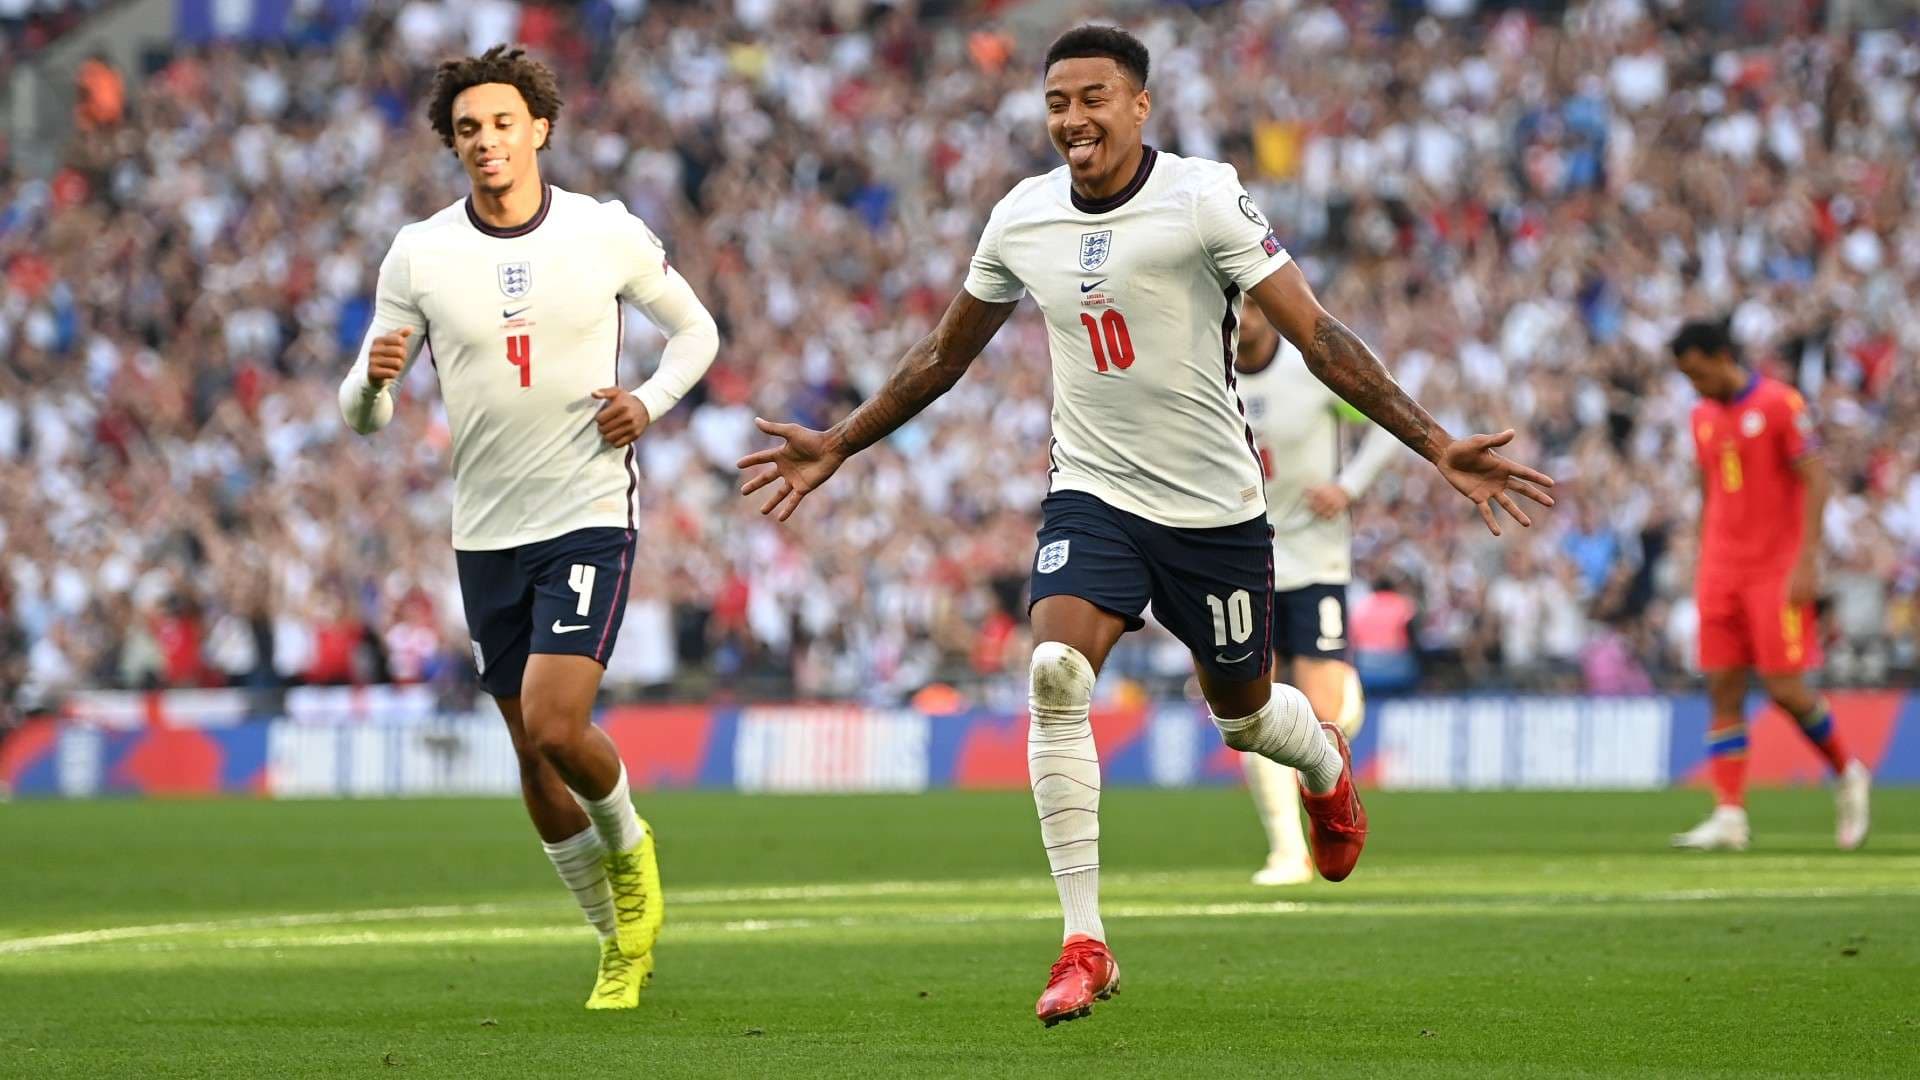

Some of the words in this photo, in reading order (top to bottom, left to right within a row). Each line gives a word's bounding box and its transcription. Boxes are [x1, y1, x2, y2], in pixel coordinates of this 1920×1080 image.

[506, 335, 531, 387] 4
[1080, 309, 1135, 372] 10
[568, 564, 596, 616] 4
[1206, 589, 1252, 646] 10
